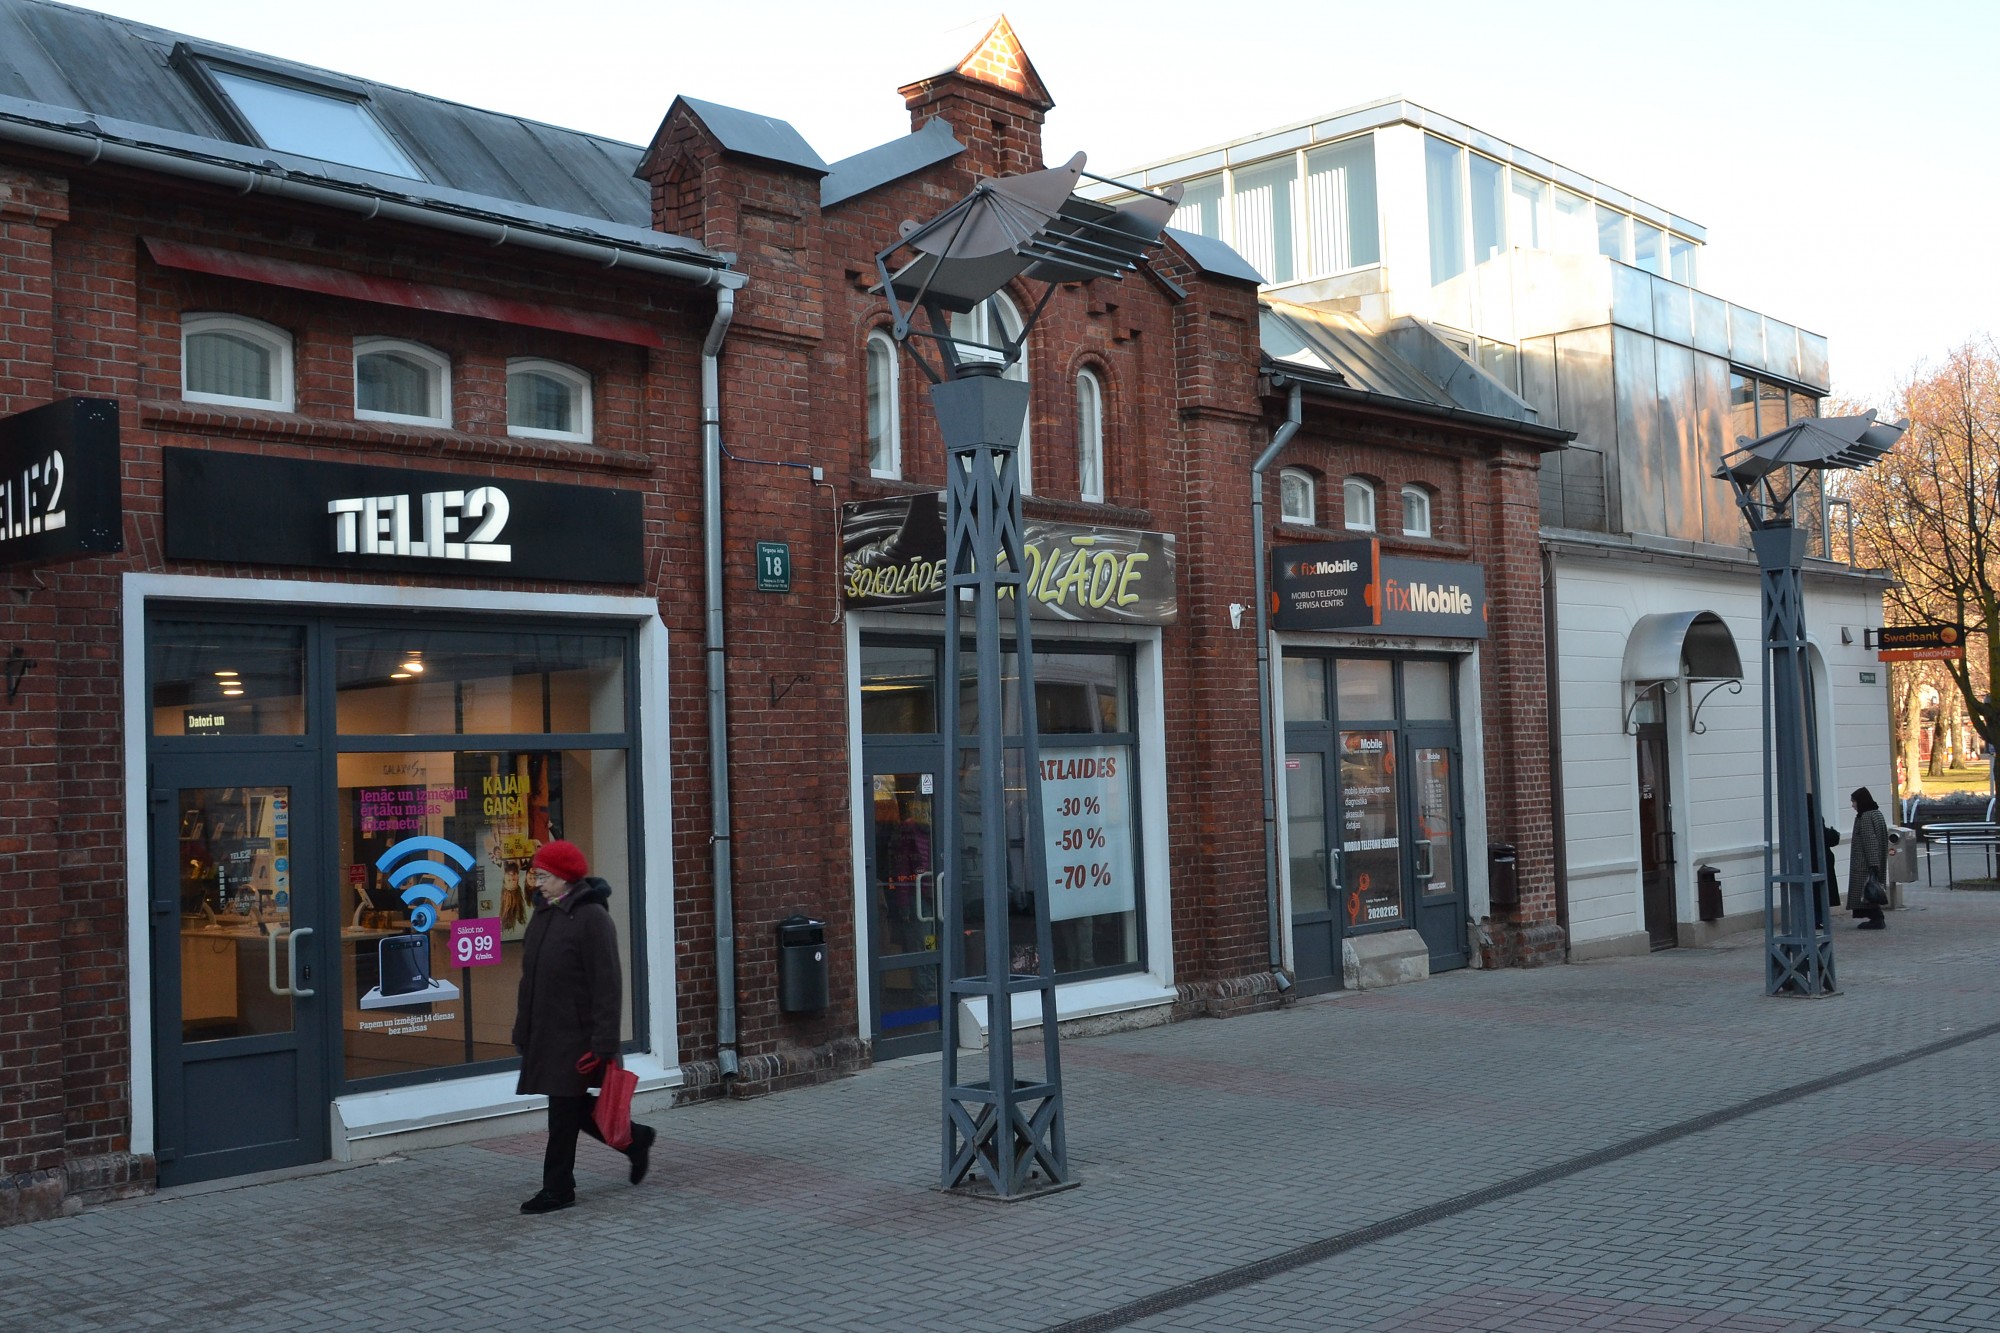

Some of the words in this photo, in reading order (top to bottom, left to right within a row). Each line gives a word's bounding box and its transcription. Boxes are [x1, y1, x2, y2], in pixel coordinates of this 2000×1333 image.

[328, 486, 512, 563] TELE2
[765, 556, 783, 577] 18
[1301, 559, 1359, 576] fixMobile
[847, 555, 947, 598] ŠOKOLĀDE
[1291, 591, 1316, 600] MOBILO
[1316, 588, 1348, 598] TELEFONU
[1385, 578, 1473, 615] fixMobile
[1295, 601, 1320, 610] SERVISA
[1320, 599, 1344, 608] CENTRS
[1883, 631, 1940, 643] Swedbank
[1913, 649, 1957, 659] BANKOMĀTS
[188, 713, 213, 728] Datori
[213, 715, 225, 726] un
[1039, 756, 1116, 781] ATLAIDES
[360, 789, 395, 803] Ienāc
[398, 790, 414, 802] un
[360, 803, 402, 817] ērtāku
[1057, 797, 1081, 816] -30
[1084, 796, 1100, 815] %
[1055, 828, 1083, 851] -50
[1087, 827, 1106, 849] %
[1055, 864, 1086, 890] -70
[1090, 862, 1112, 887] %
[1367, 905, 1399, 919] 20202125
[475, 926, 484, 934] no
[359, 1021, 384, 1031] Paņem
[384, 1019, 394, 1028] un
[424, 1014, 433, 1023] 14
[432, 1011, 455, 1022] dienas
[388, 1025, 401, 1036] bez
[401, 1023, 428, 1034] maksas
